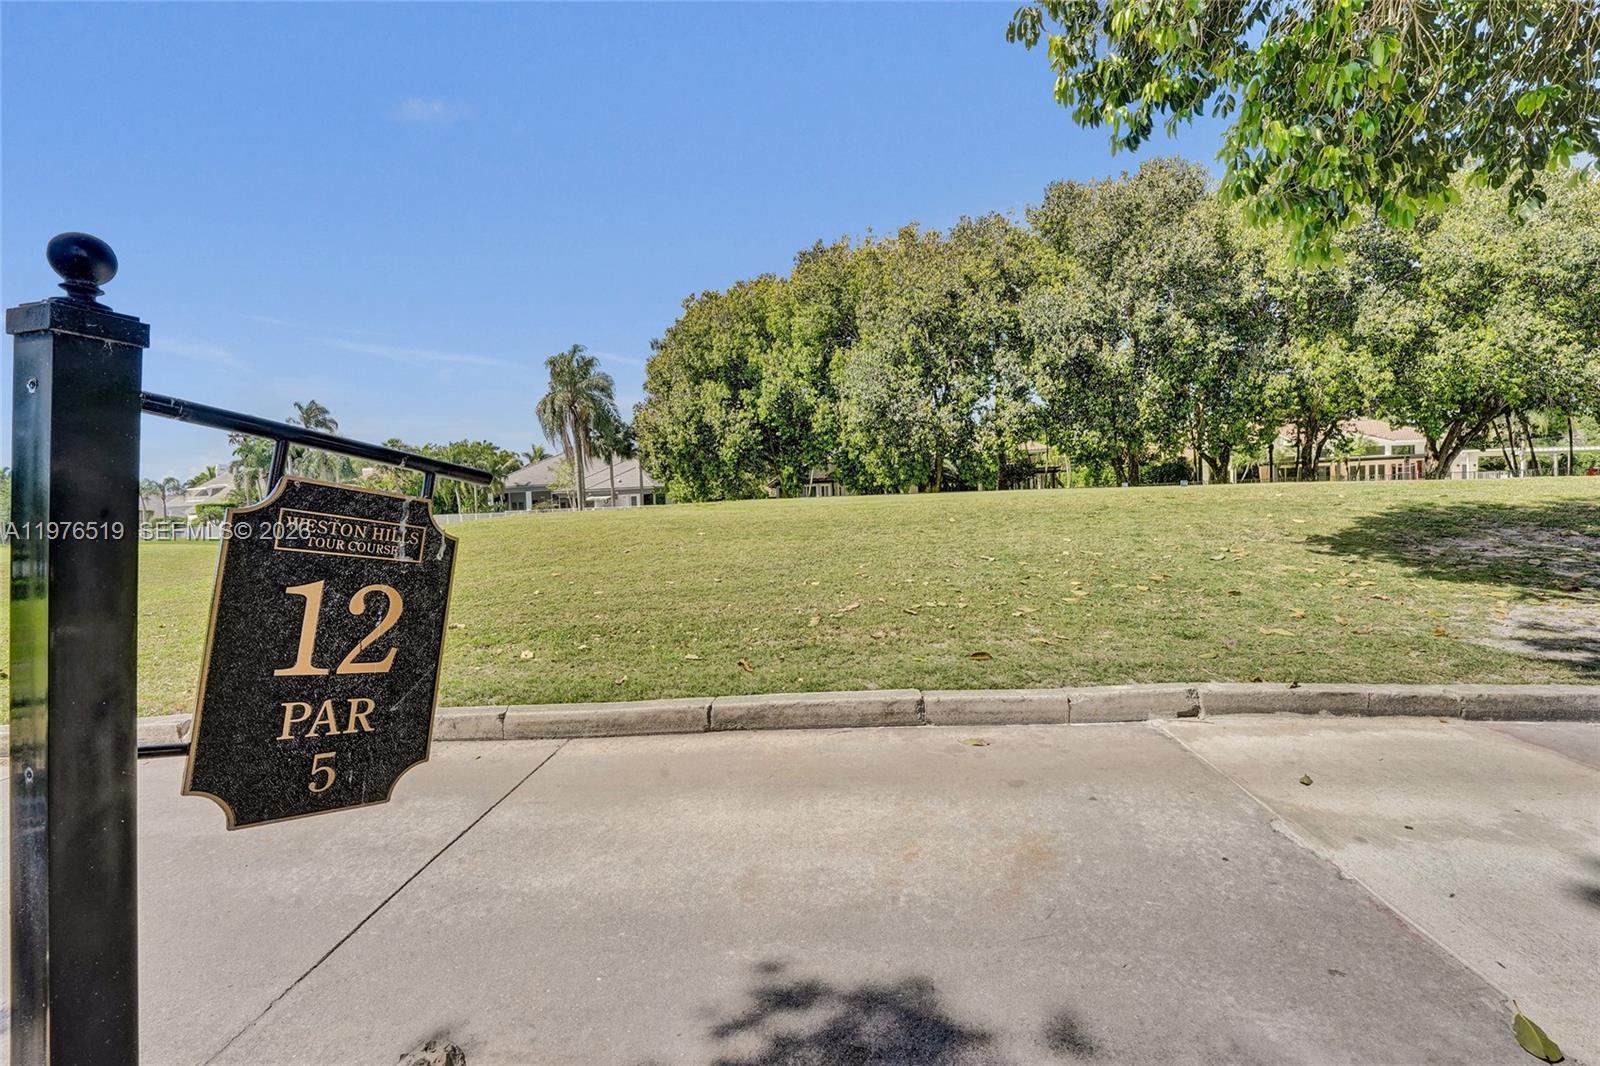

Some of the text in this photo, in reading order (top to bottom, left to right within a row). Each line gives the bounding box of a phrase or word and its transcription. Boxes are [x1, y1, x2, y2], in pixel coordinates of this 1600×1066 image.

[286, 515, 419, 545] WESTON HILLS
[307, 536, 345, 551] TOUR
[274, 580, 404, 676] 12
[276, 698, 376, 741] PAR
[308, 752, 337, 793] 5
